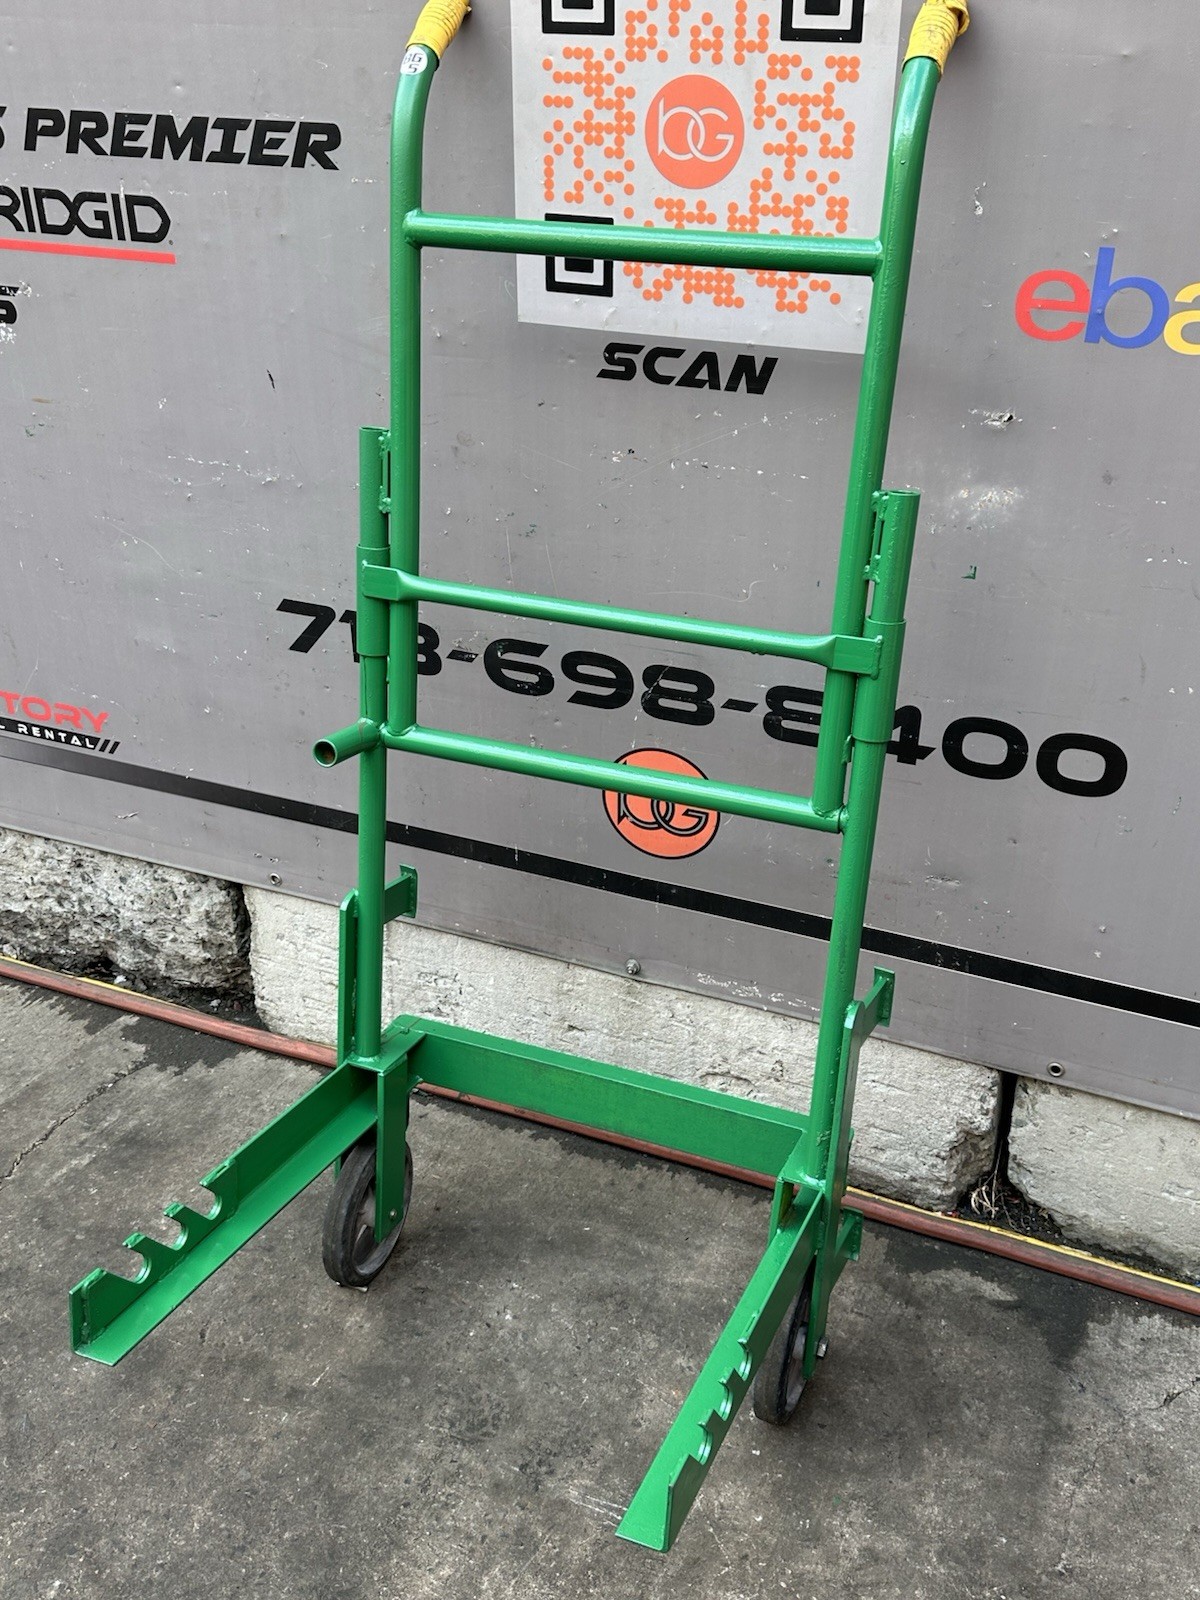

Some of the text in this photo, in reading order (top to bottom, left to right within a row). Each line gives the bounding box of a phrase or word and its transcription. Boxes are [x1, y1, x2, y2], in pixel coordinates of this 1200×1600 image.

[24, 107, 342, 170] PREMIER
[0, 185, 171, 244] RIDGID
[596, 342, 779, 395] SCAN
[0, 690, 109, 733] TORY
[17, 723, 95, 749] RENTAL
